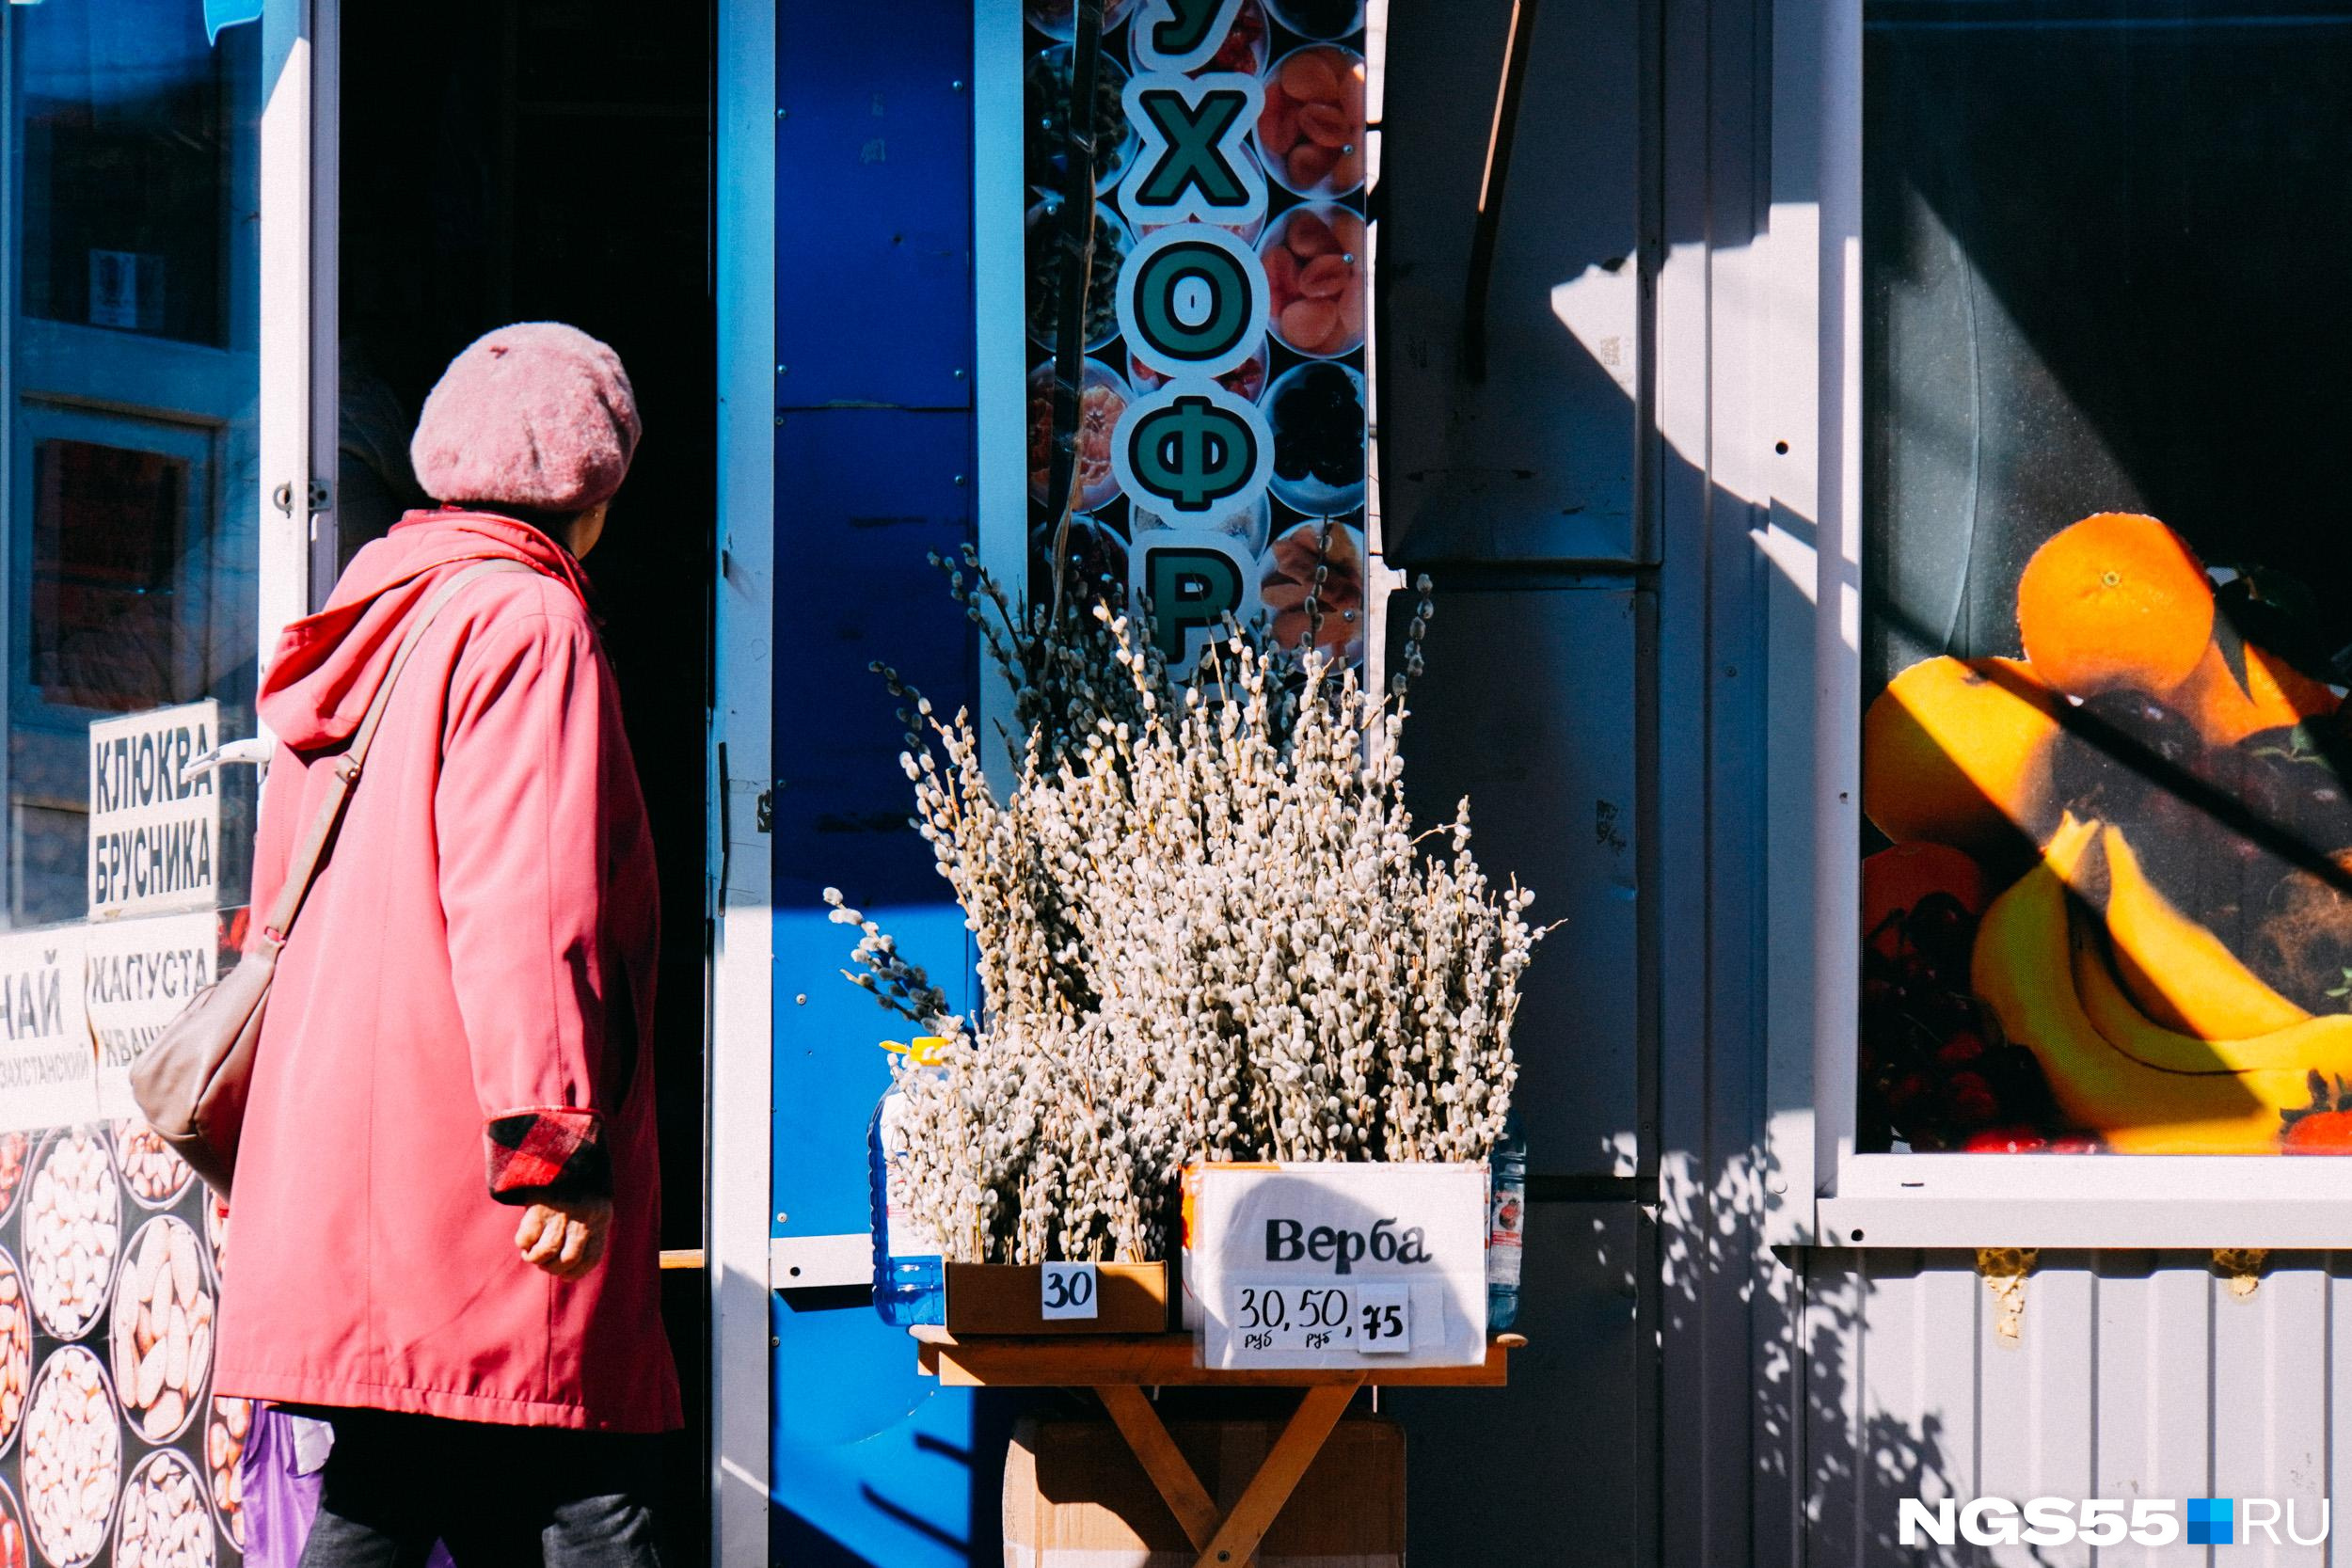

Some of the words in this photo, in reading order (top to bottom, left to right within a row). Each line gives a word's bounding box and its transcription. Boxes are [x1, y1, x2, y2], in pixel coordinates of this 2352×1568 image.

[96, 723, 213, 815] КЛЮКВА
[95, 816, 211, 904] БРУСНИКА
[91, 948, 208, 1004] КАПУСТА
[1265, 1217, 1433, 1275] Верба
[1044, 1271, 1093, 1308] 30
[1244, 1329, 1273, 1350] руб
[1305, 1329, 1332, 1350] руб
[1362, 1305, 1405, 1339] 75
